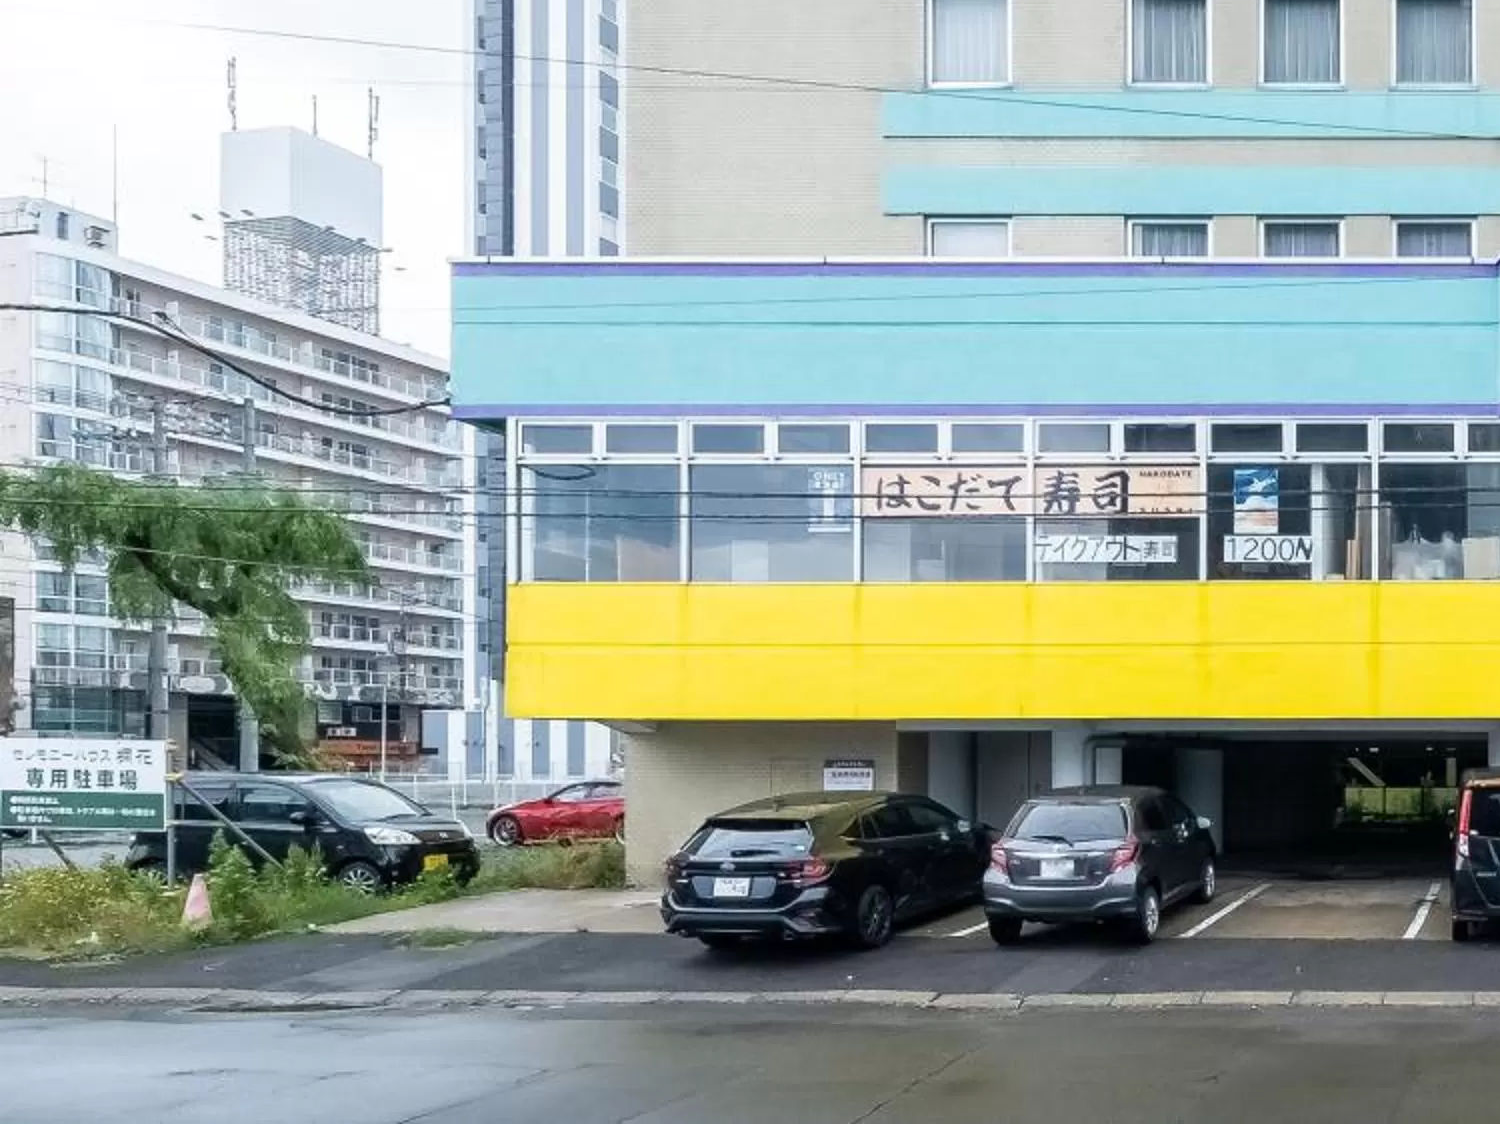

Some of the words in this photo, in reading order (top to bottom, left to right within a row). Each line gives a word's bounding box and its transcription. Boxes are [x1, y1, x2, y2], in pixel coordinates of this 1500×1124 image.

[26, 767, 138, 790] 専用駐車場
